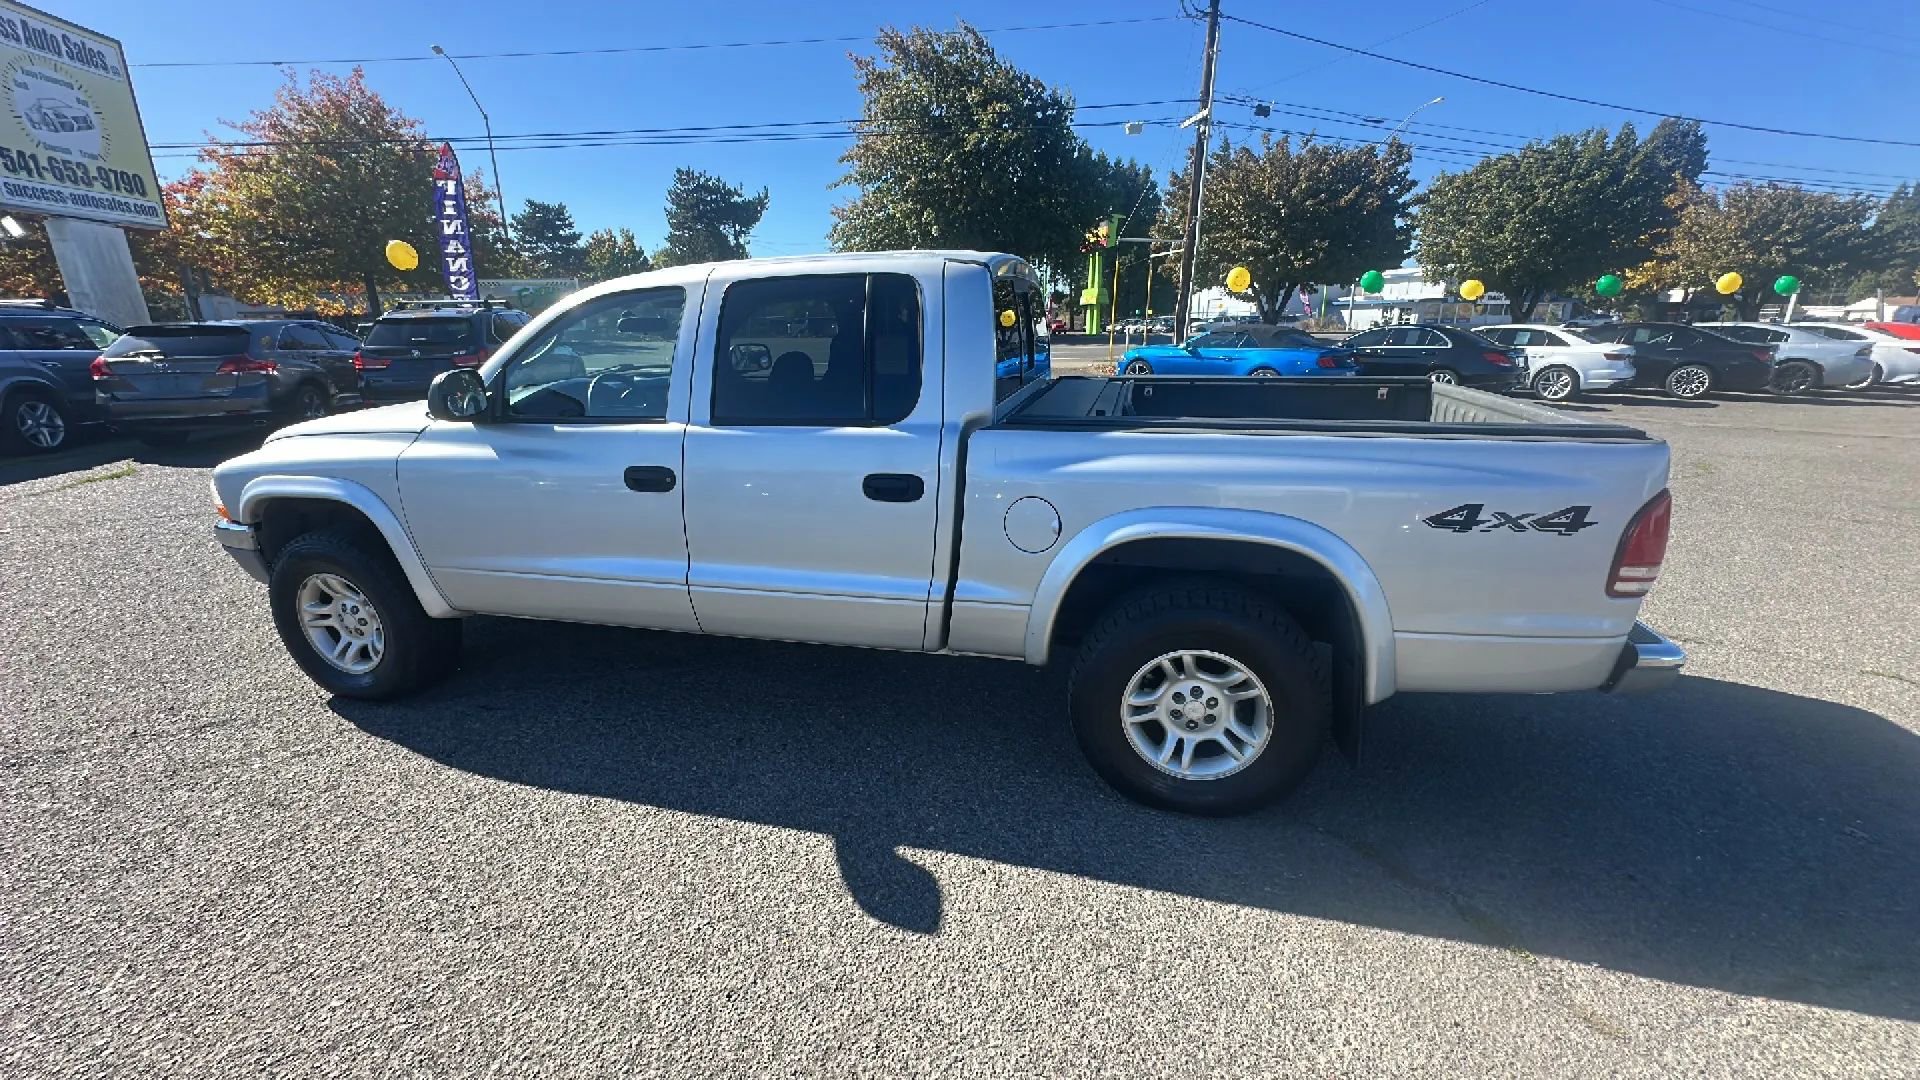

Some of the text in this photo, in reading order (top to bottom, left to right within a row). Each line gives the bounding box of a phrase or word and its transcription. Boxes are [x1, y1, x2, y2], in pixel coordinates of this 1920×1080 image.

[20, 18, 63, 58] Auto
[62, 33, 110, 74] Sales
[0, 146, 147, 197] 541-653-9790
[3, 182, 159, 217] success-autosales.com
